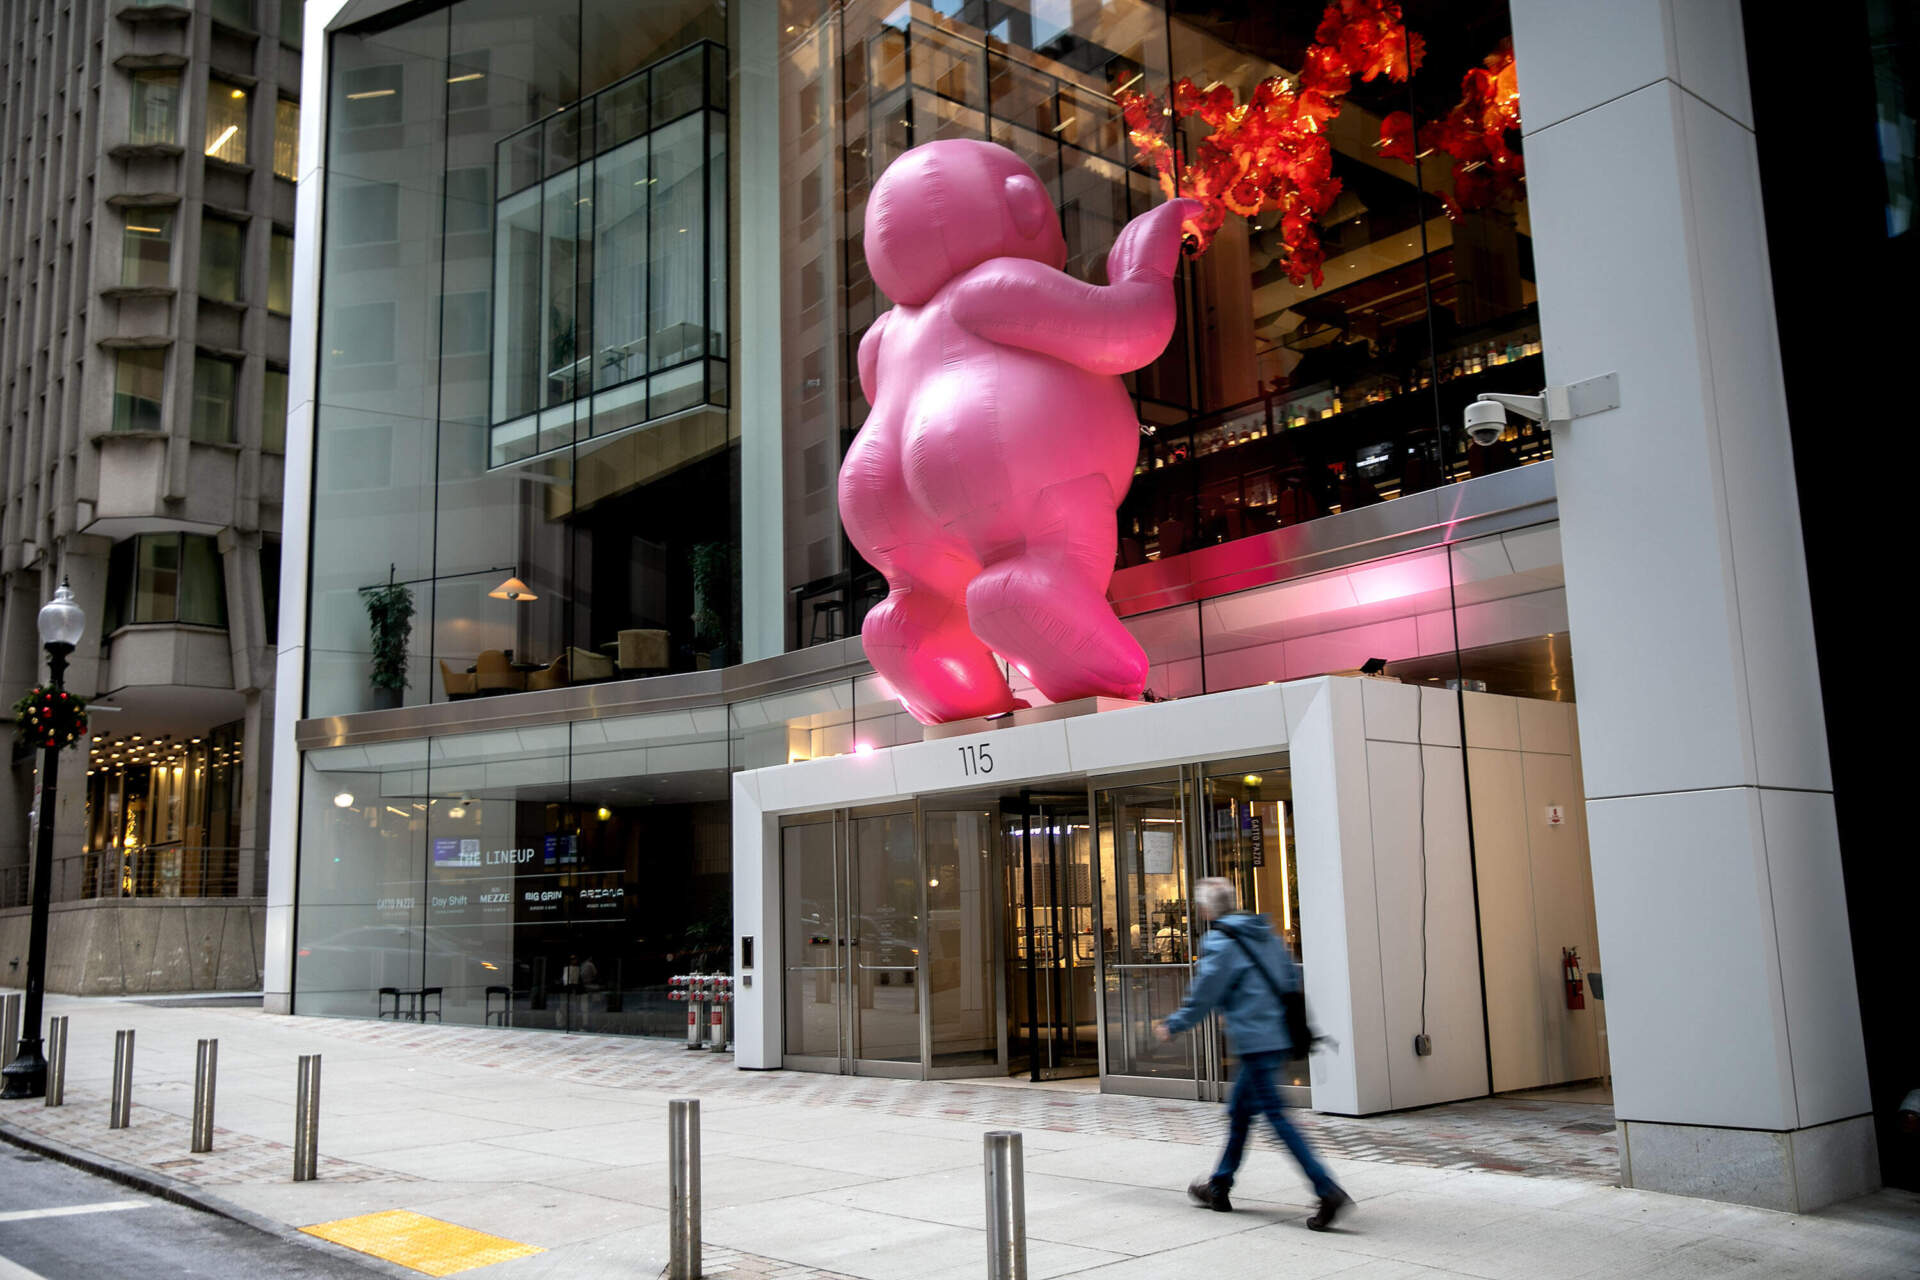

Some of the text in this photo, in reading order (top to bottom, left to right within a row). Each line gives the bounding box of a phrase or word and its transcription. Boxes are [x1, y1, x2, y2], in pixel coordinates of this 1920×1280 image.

[958, 743, 993, 776] 115
[486, 848, 535, 865] LINEUP
[432, 894, 468, 909] Day Shift
[480, 893, 511, 904] MEZZE
[525, 890, 563, 902] BIG GRIN
